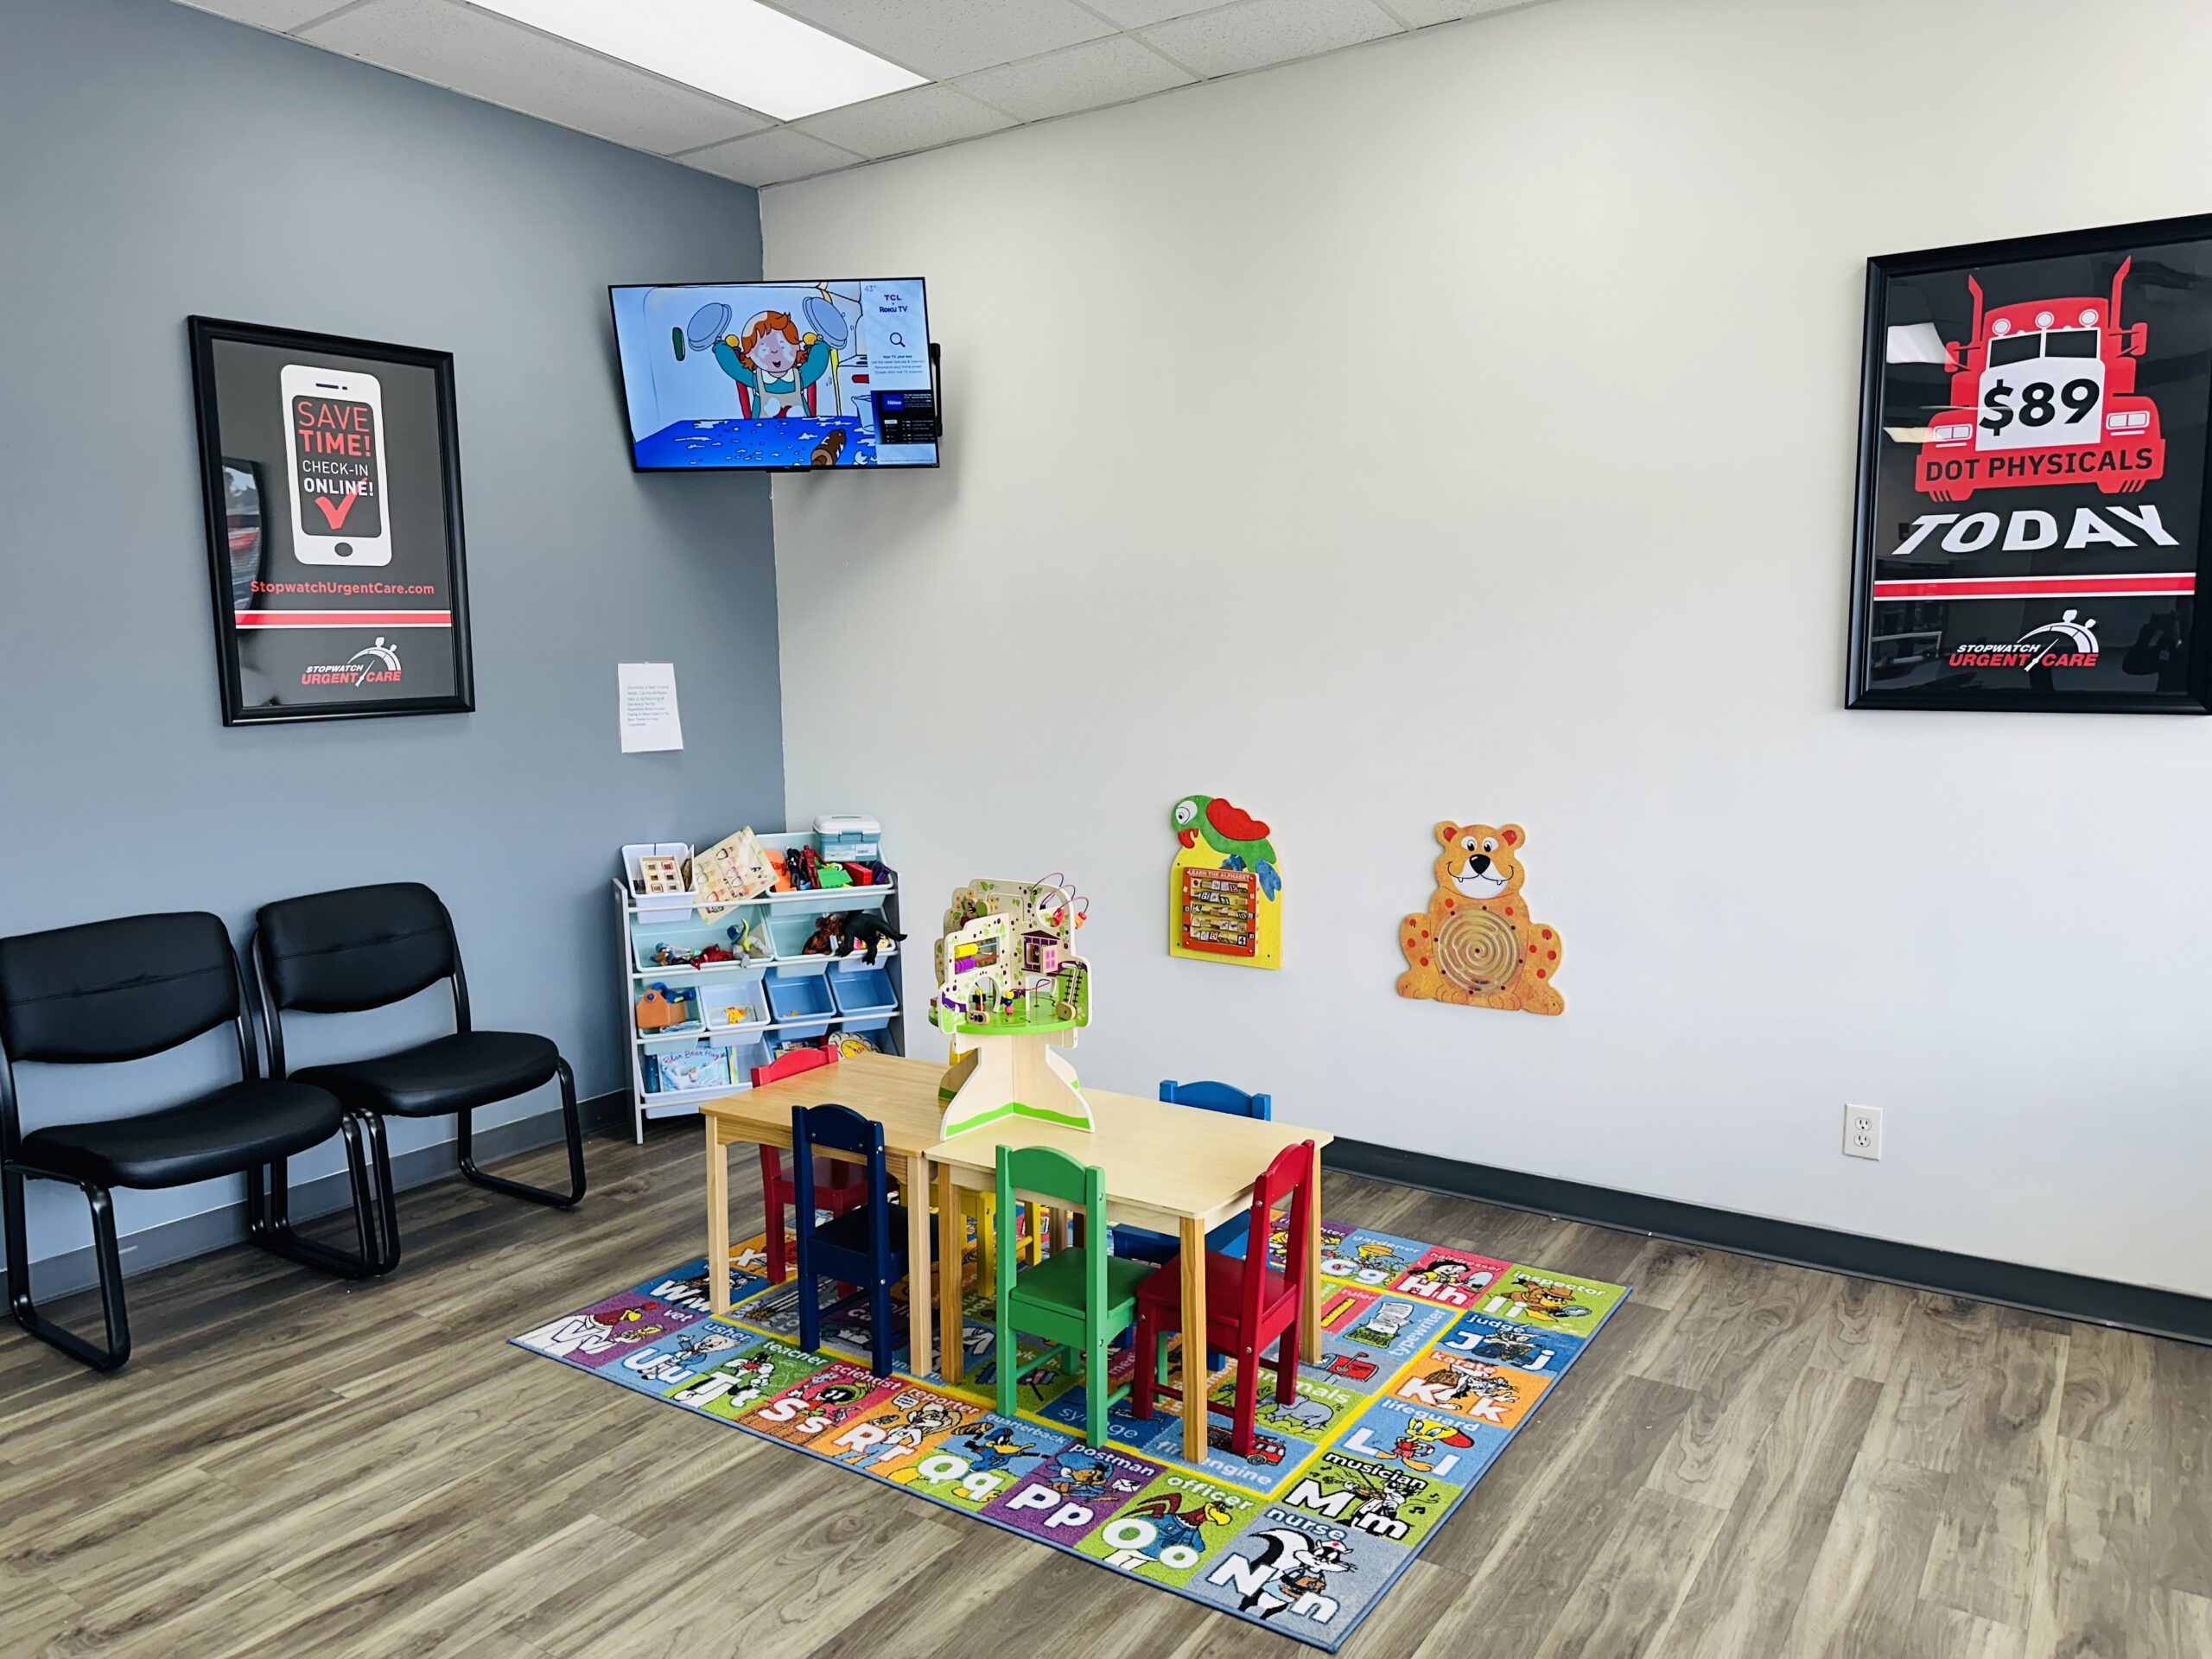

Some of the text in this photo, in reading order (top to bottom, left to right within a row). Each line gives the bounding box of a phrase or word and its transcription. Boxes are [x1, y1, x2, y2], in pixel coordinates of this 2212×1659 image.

[297, 401, 370, 433] SAVE
[1980, 378, 2100, 435] $89
[298, 430, 372, 457] TIME!
[302, 460, 368, 477] CHECK-IN
[1926, 448, 2153, 482] DOT PHYSICALS
[303, 476, 374, 497] ONLINE!
[1891, 505, 2181, 556] TODAY
[251, 580, 435, 595] StopwatchUrgentCare.com
[1948, 652, 2100, 667] URGENT CARE
[1956, 643, 2041, 653] STOPWATCH
[301, 671, 402, 685] URGENT CARE
[306, 664, 364, 673] STOPWATCH
[1353, 1236, 1421, 1253] gardener
[1431, 1252, 1503, 1273] hairdresser
[1514, 1271, 1606, 1296] inspector
[664, 1309, 692, 1322] vet
[1467, 1314, 1524, 1333] judge
[704, 1323, 752, 1341] usher
[1389, 1308, 1446, 1356] typewriter
[763, 1341, 828, 1365] teacher
[1431, 1351, 1497, 1375] karate
[908, 1388, 981, 1414] reporter
[1382, 1399, 1479, 1432] lifeguard
[986, 1414, 1067, 1444] quarterback
[1070, 1444, 1156, 1477] postman
[1205, 1458, 1272, 1485] ngine
[1324, 1453, 1428, 1490] musician
[1167, 1477, 1254, 1510] officer
[1267, 1508, 1346, 1541] nurse
